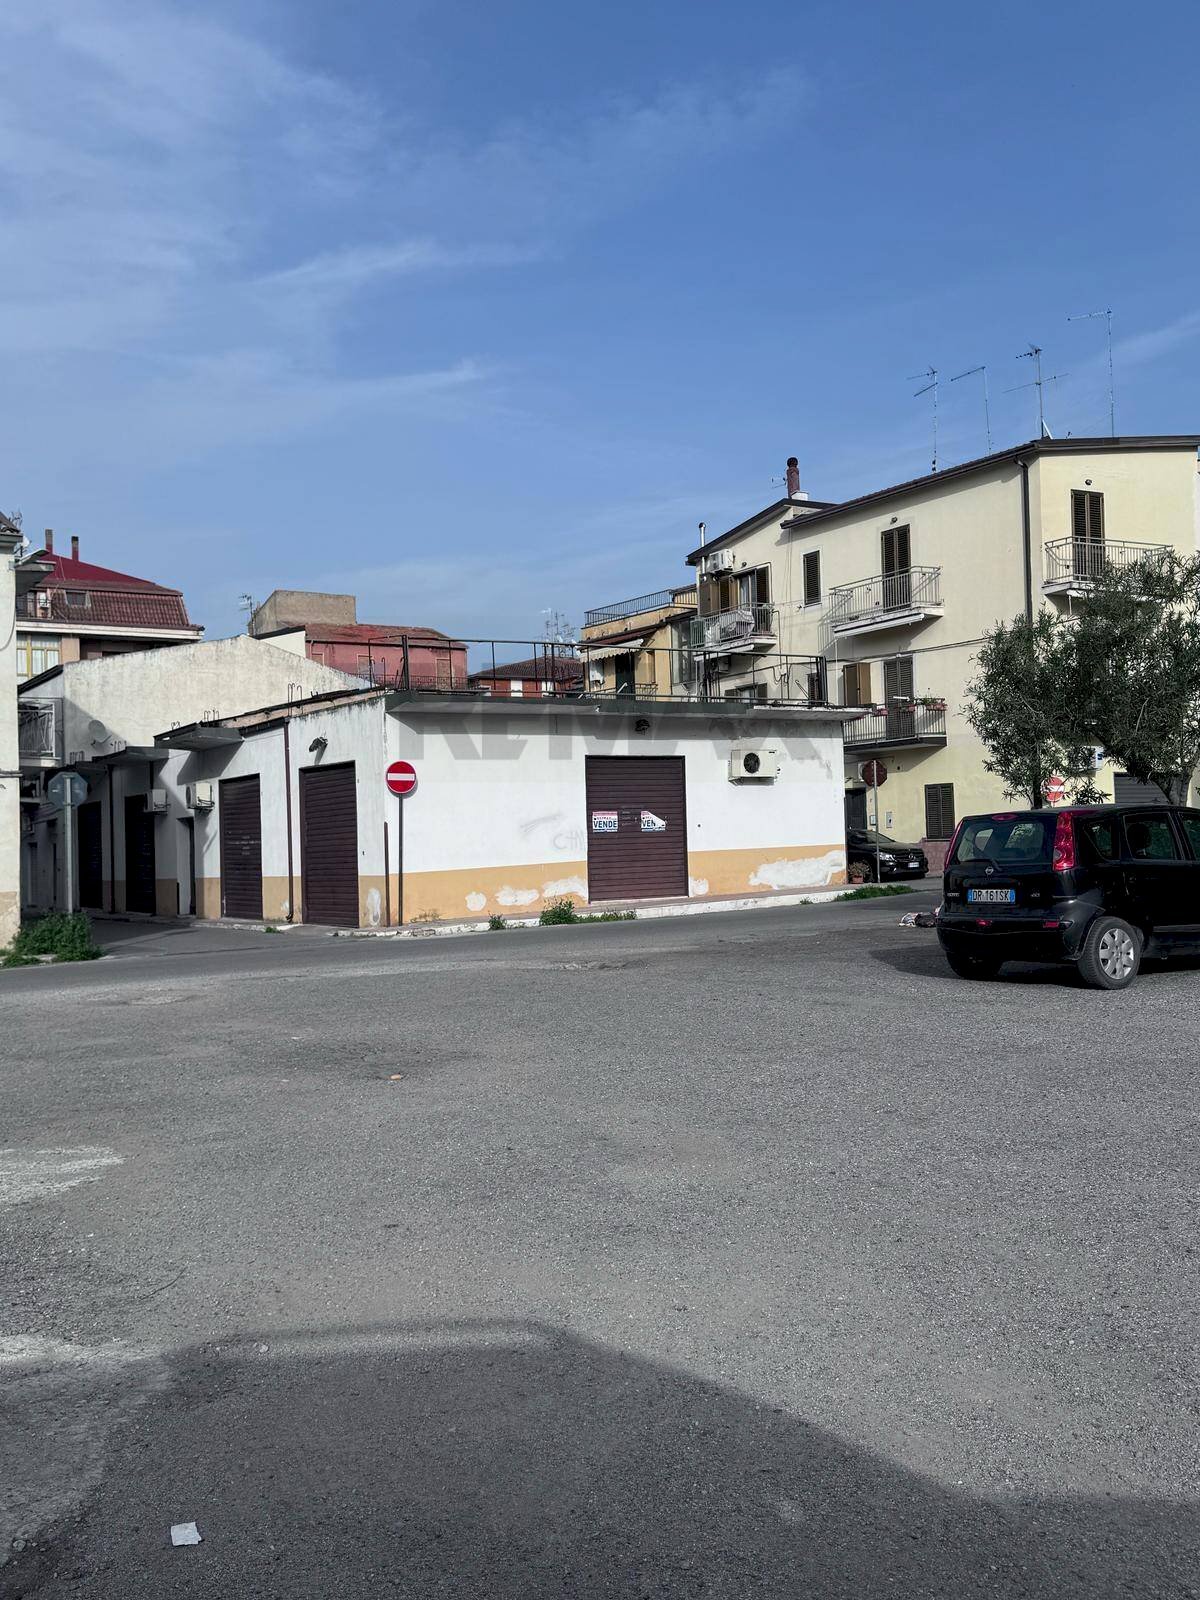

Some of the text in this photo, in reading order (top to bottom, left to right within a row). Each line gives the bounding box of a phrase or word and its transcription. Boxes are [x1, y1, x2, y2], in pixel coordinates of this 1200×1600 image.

[593, 820, 618, 829] VENDE
[973, 890, 982, 901] DR
[985, 890, 1009, 901] 161SK
